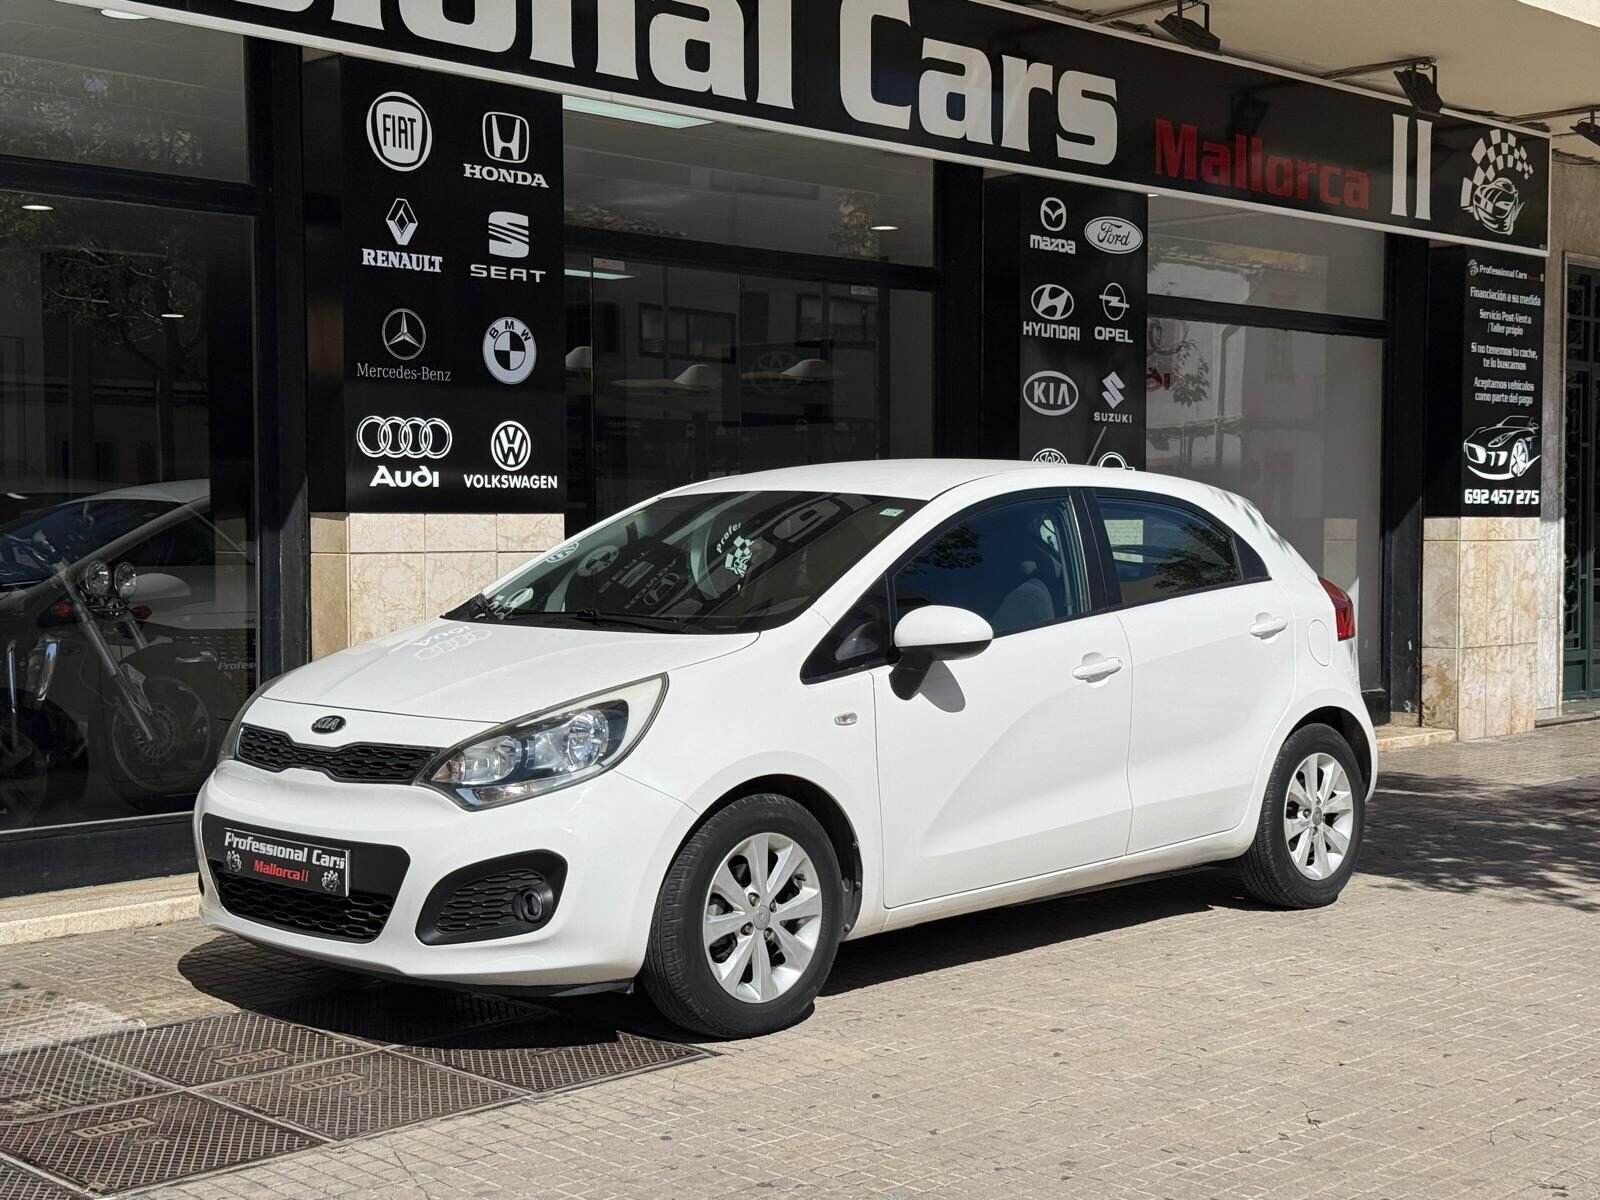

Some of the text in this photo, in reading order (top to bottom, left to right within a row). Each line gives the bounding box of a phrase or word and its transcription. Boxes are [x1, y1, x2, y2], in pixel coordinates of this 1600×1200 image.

[839, 0, 1118, 165] Cars
[1154, 118, 1370, 210] Mallorca
[383, 113, 417, 151] FIAT
[463, 163, 549, 188] HONDA
[1097, 221, 1131, 247] Ford
[361, 248, 443, 273] RENAULT
[470, 264, 546, 283] SEAT
[1512, 294, 1520, 304] su
[1520, 294, 1542, 307] medida
[1479, 308, 1502, 321] Servicio
[1023, 321, 1081, 341] HYUNDAI
[1094, 326, 1134, 343] OPEL
[1471, 341, 1478, 353] Si
[1477, 344, 1486, 354] no
[1486, 344, 1512, 357] tenemos
[356, 363, 451, 382] Mercedes-Benz
[1483, 357, 1527, 371] te lo buscamos
[1473, 376, 1508, 391] Aceptamos
[1033, 381, 1070, 406] KIA
[1474, 392, 1534, 407] como parte del pago
[1093, 411, 1133, 424] SUZUKI
[369, 465, 440, 488] Audi
[463, 474, 558, 489] VOLKSWAGEN
[1464, 488, 1540, 505] 692 457 275
[223, 831, 346, 869] Professional Cars
[253, 859, 300, 881] Mallorca
